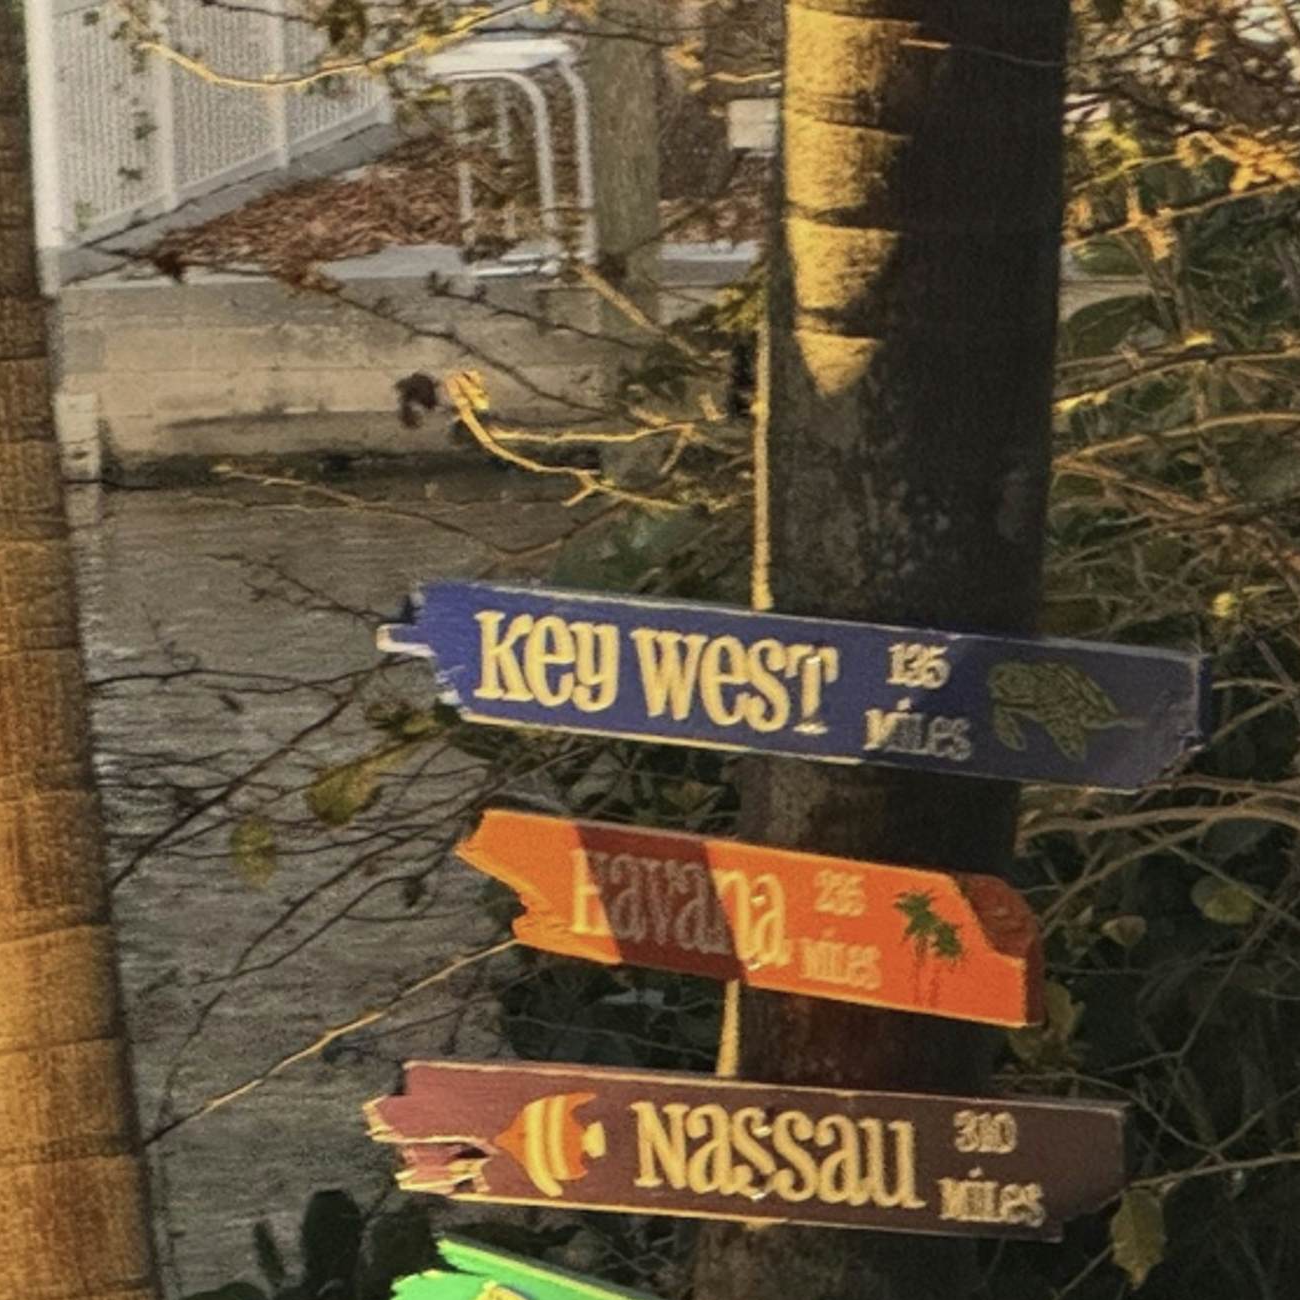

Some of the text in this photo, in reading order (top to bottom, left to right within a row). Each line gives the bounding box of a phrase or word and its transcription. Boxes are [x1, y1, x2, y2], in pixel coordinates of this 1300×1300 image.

[474, 610, 619, 712] Key
[886, 643, 951, 689] 135
[571, 848, 791, 968] Havana
[630, 1101, 926, 1209] Nassau
[954, 1109, 1017, 1154] 310
